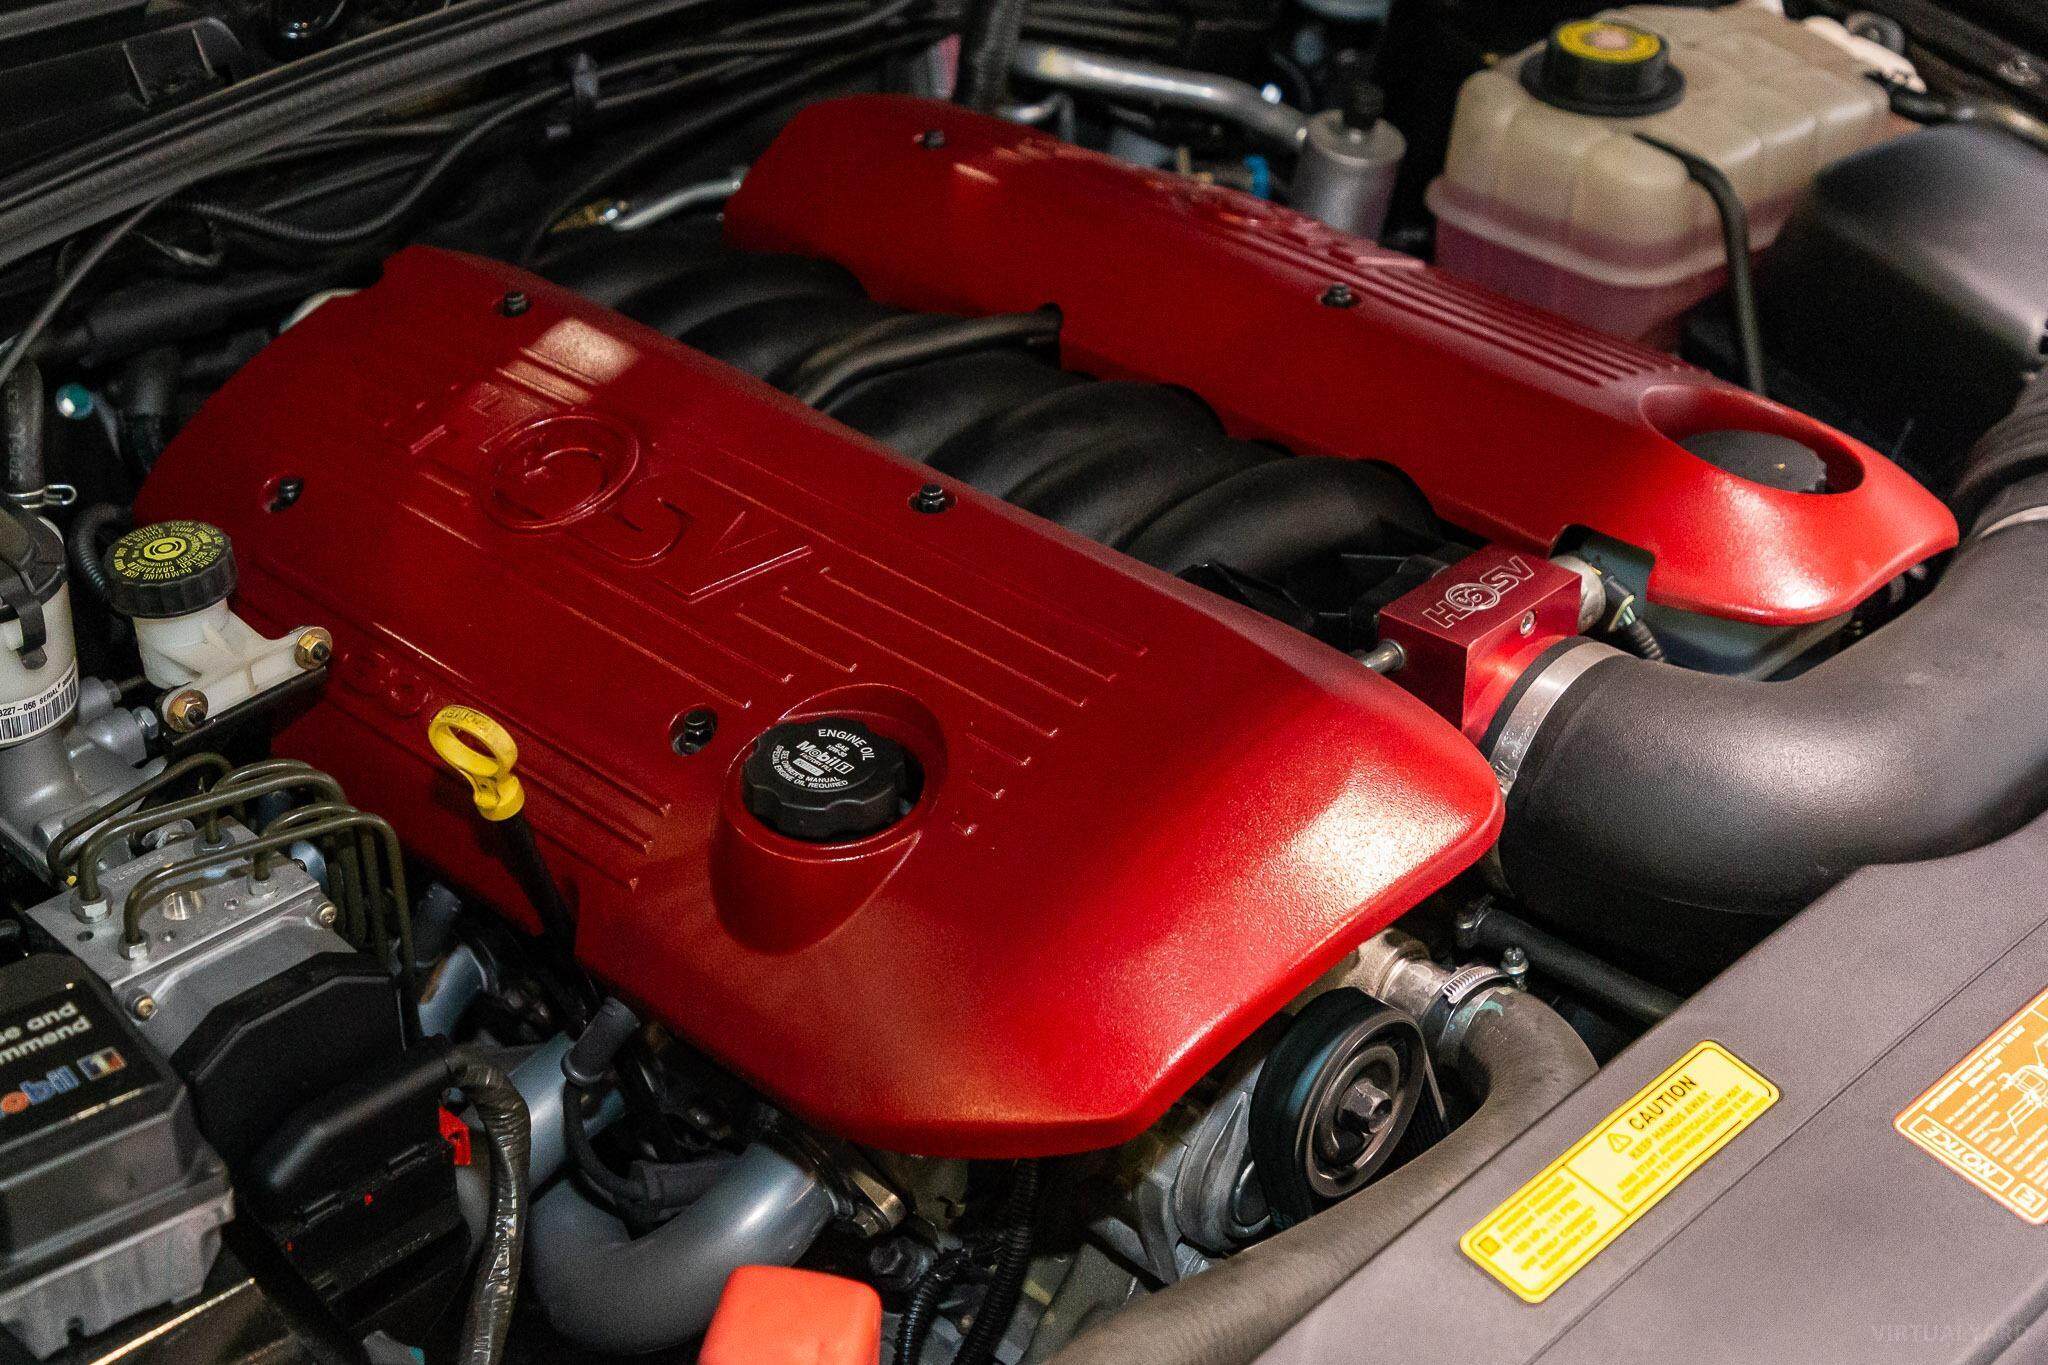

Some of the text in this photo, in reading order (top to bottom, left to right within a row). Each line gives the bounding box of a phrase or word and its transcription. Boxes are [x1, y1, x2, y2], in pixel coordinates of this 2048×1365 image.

[796, 740, 841, 767] Mobil
[818, 729, 875, 761] ENGINE OIL
[794, 779, 806, 787] OIL
[807, 780, 849, 789] REQUIRED
[26, 1001, 78, 1031] and
[0, 1064, 80, 1119] obil
[1629, 1075, 1697, 1131] CAUTION
[1920, 1125, 2000, 1177] NOTICE
